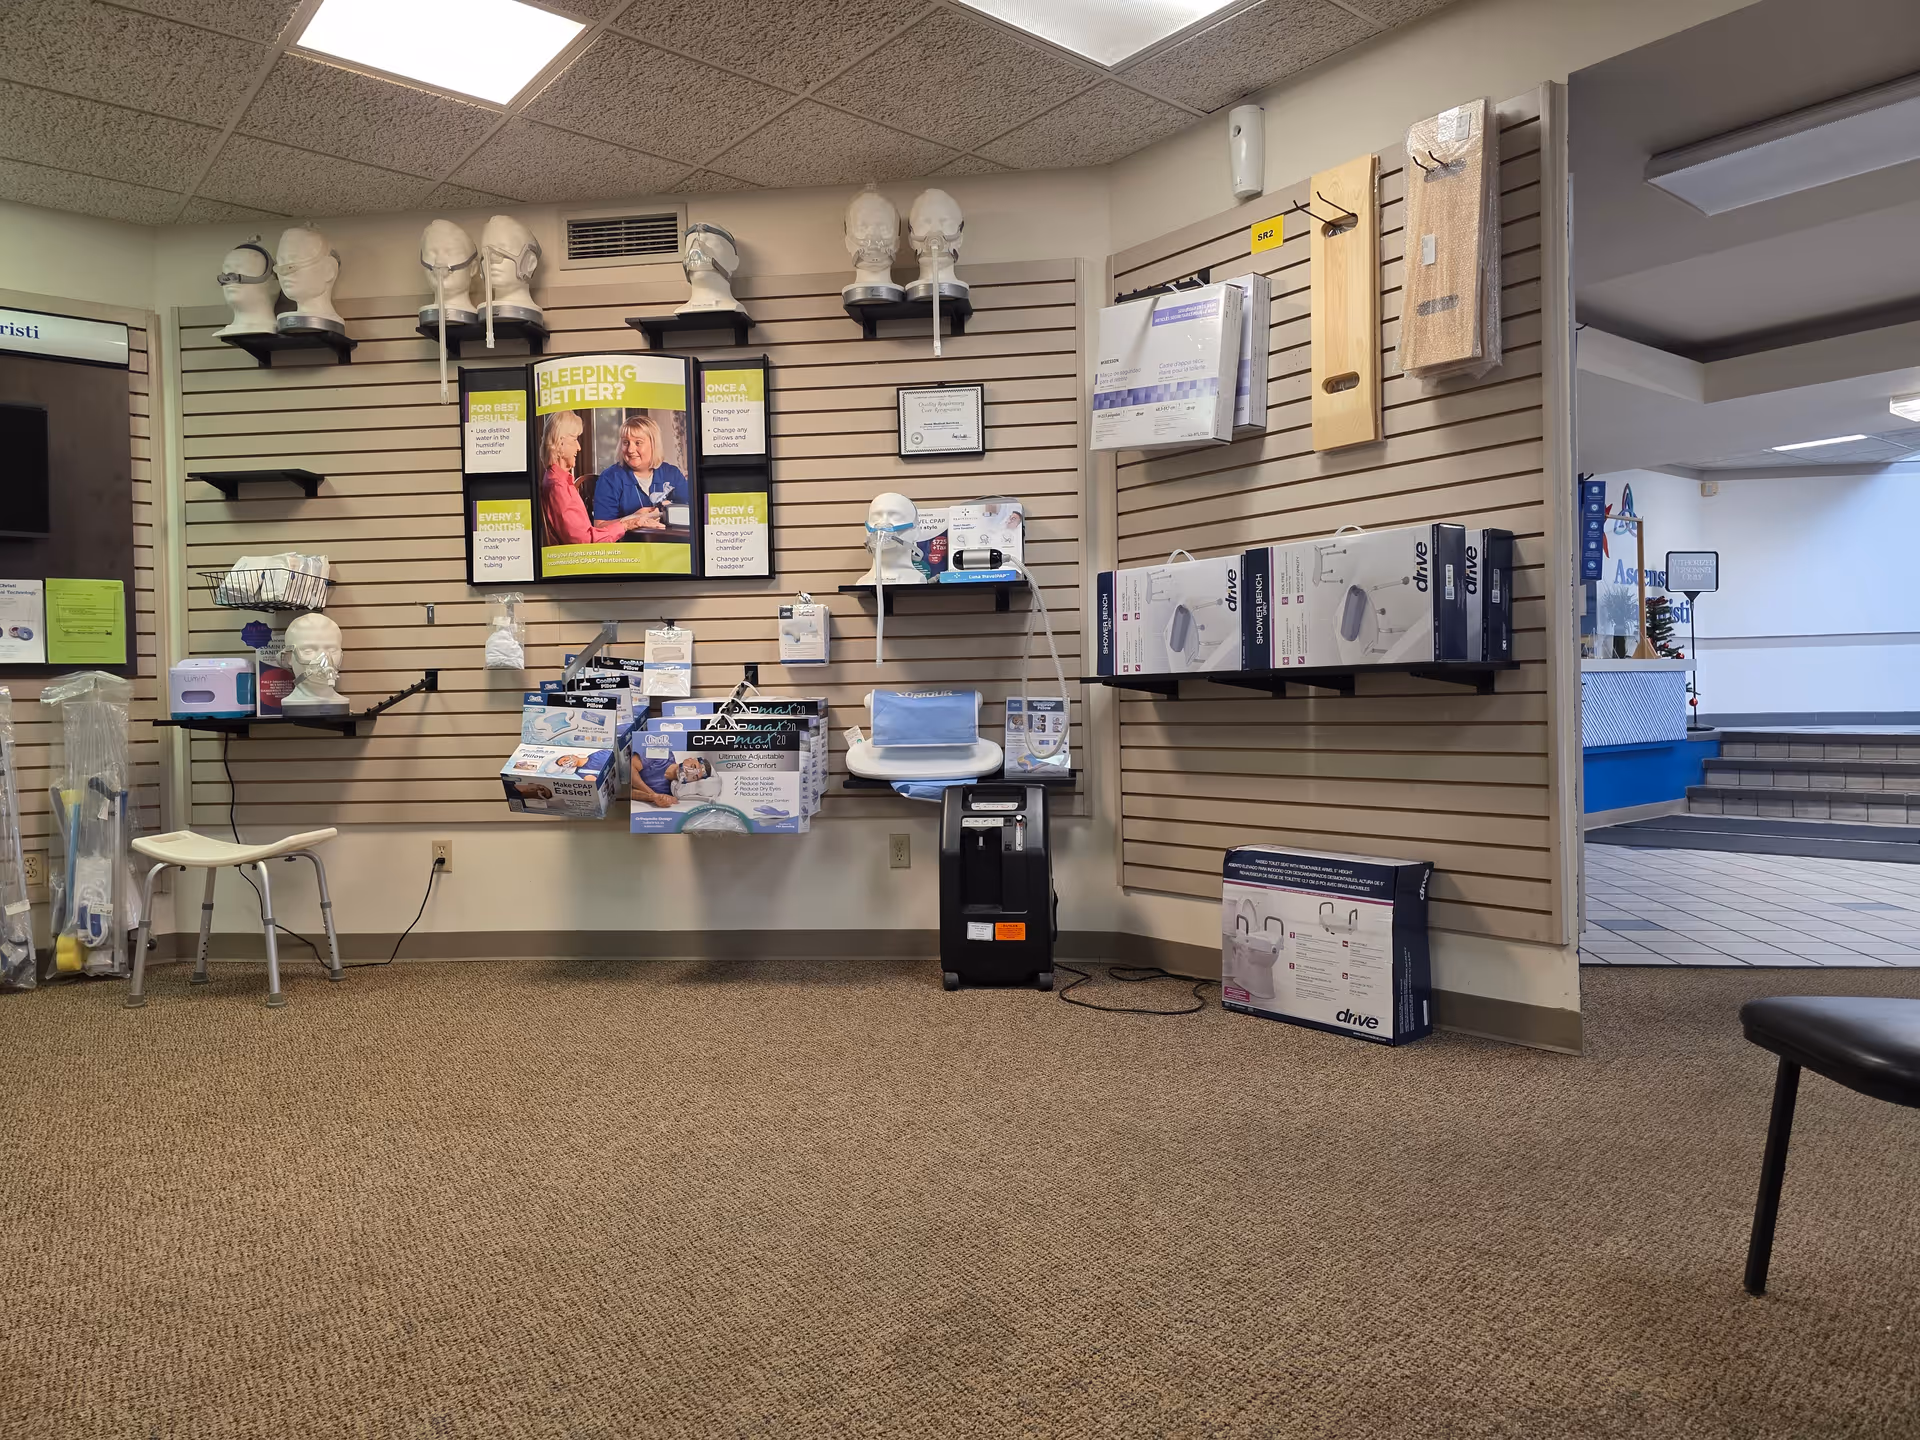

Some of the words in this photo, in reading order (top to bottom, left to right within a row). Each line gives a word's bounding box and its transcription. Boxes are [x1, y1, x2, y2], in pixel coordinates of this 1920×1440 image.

[1257, 229, 1274, 242] SR2
[0, 322, 40, 340] risti
[540, 364, 637, 389] SLEEPING
[706, 384, 737, 392] ONCE
[738, 384, 748, 392] A
[540, 382, 626, 407] BETTER?
[706, 394, 748, 402] MONTH:
[470, 404, 492, 414] FOR
[494, 403, 520, 412] BEST
[470, 414, 518, 423] RESULTS:
[710, 506, 745, 515] EVERY
[748, 506, 754, 514] 6
[479, 512, 511, 521] EVERY
[515, 512, 521, 520] 3
[710, 516, 758, 525] MONTHS:
[479, 523, 524, 531] MONTHS:
[1413, 542, 1428, 592] drive
[1466, 546, 1477, 594] drive
[1225, 568, 1238, 612] drive
[776, 735, 786, 745] 2.0
[554, 787, 591, 797] Easier!
[1420, 869, 1430, 900] drive
[1336, 1008, 1379, 1029] drive
